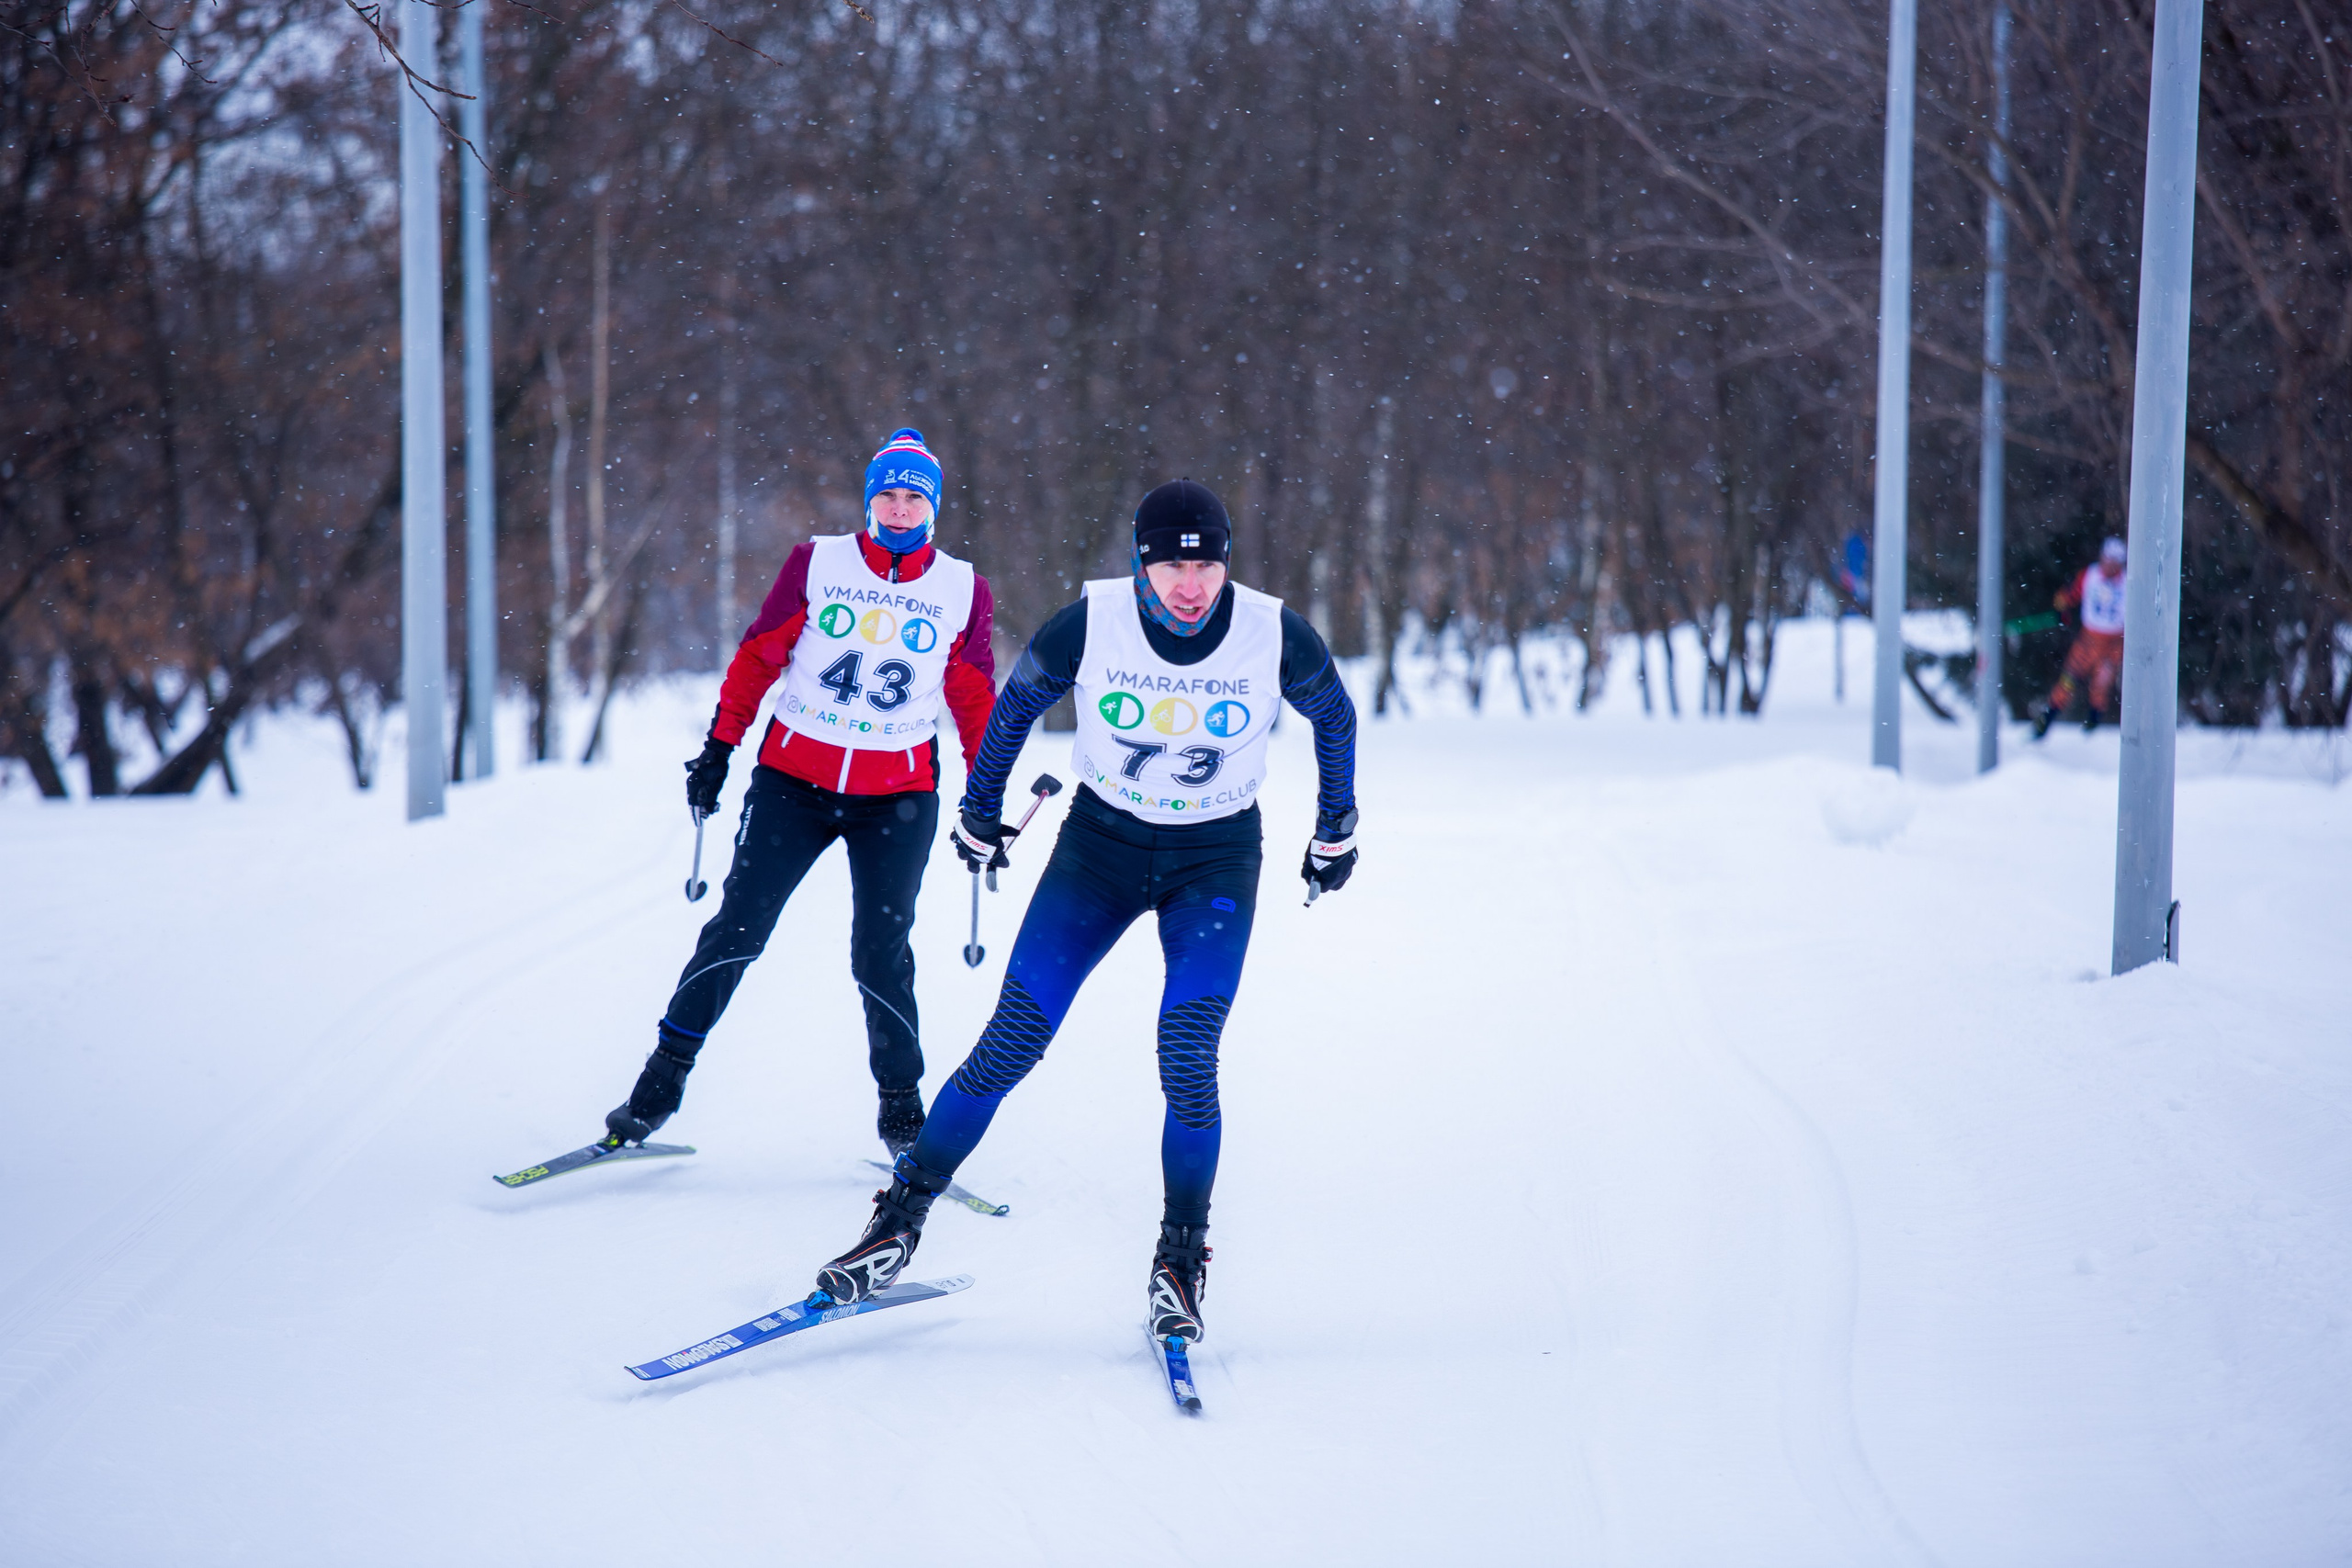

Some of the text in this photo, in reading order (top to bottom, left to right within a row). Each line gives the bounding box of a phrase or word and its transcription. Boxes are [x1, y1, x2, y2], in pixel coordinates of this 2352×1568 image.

[823, 586, 944, 619] VMARAFONE
[818, 649, 916, 712] 43
[1106, 668, 1250, 695] VMARAFONE
[1111, 733, 1225, 788] 73
[818, 1304, 861, 1325] SALOMON
[661, 1334, 732, 1371] SALOMON
